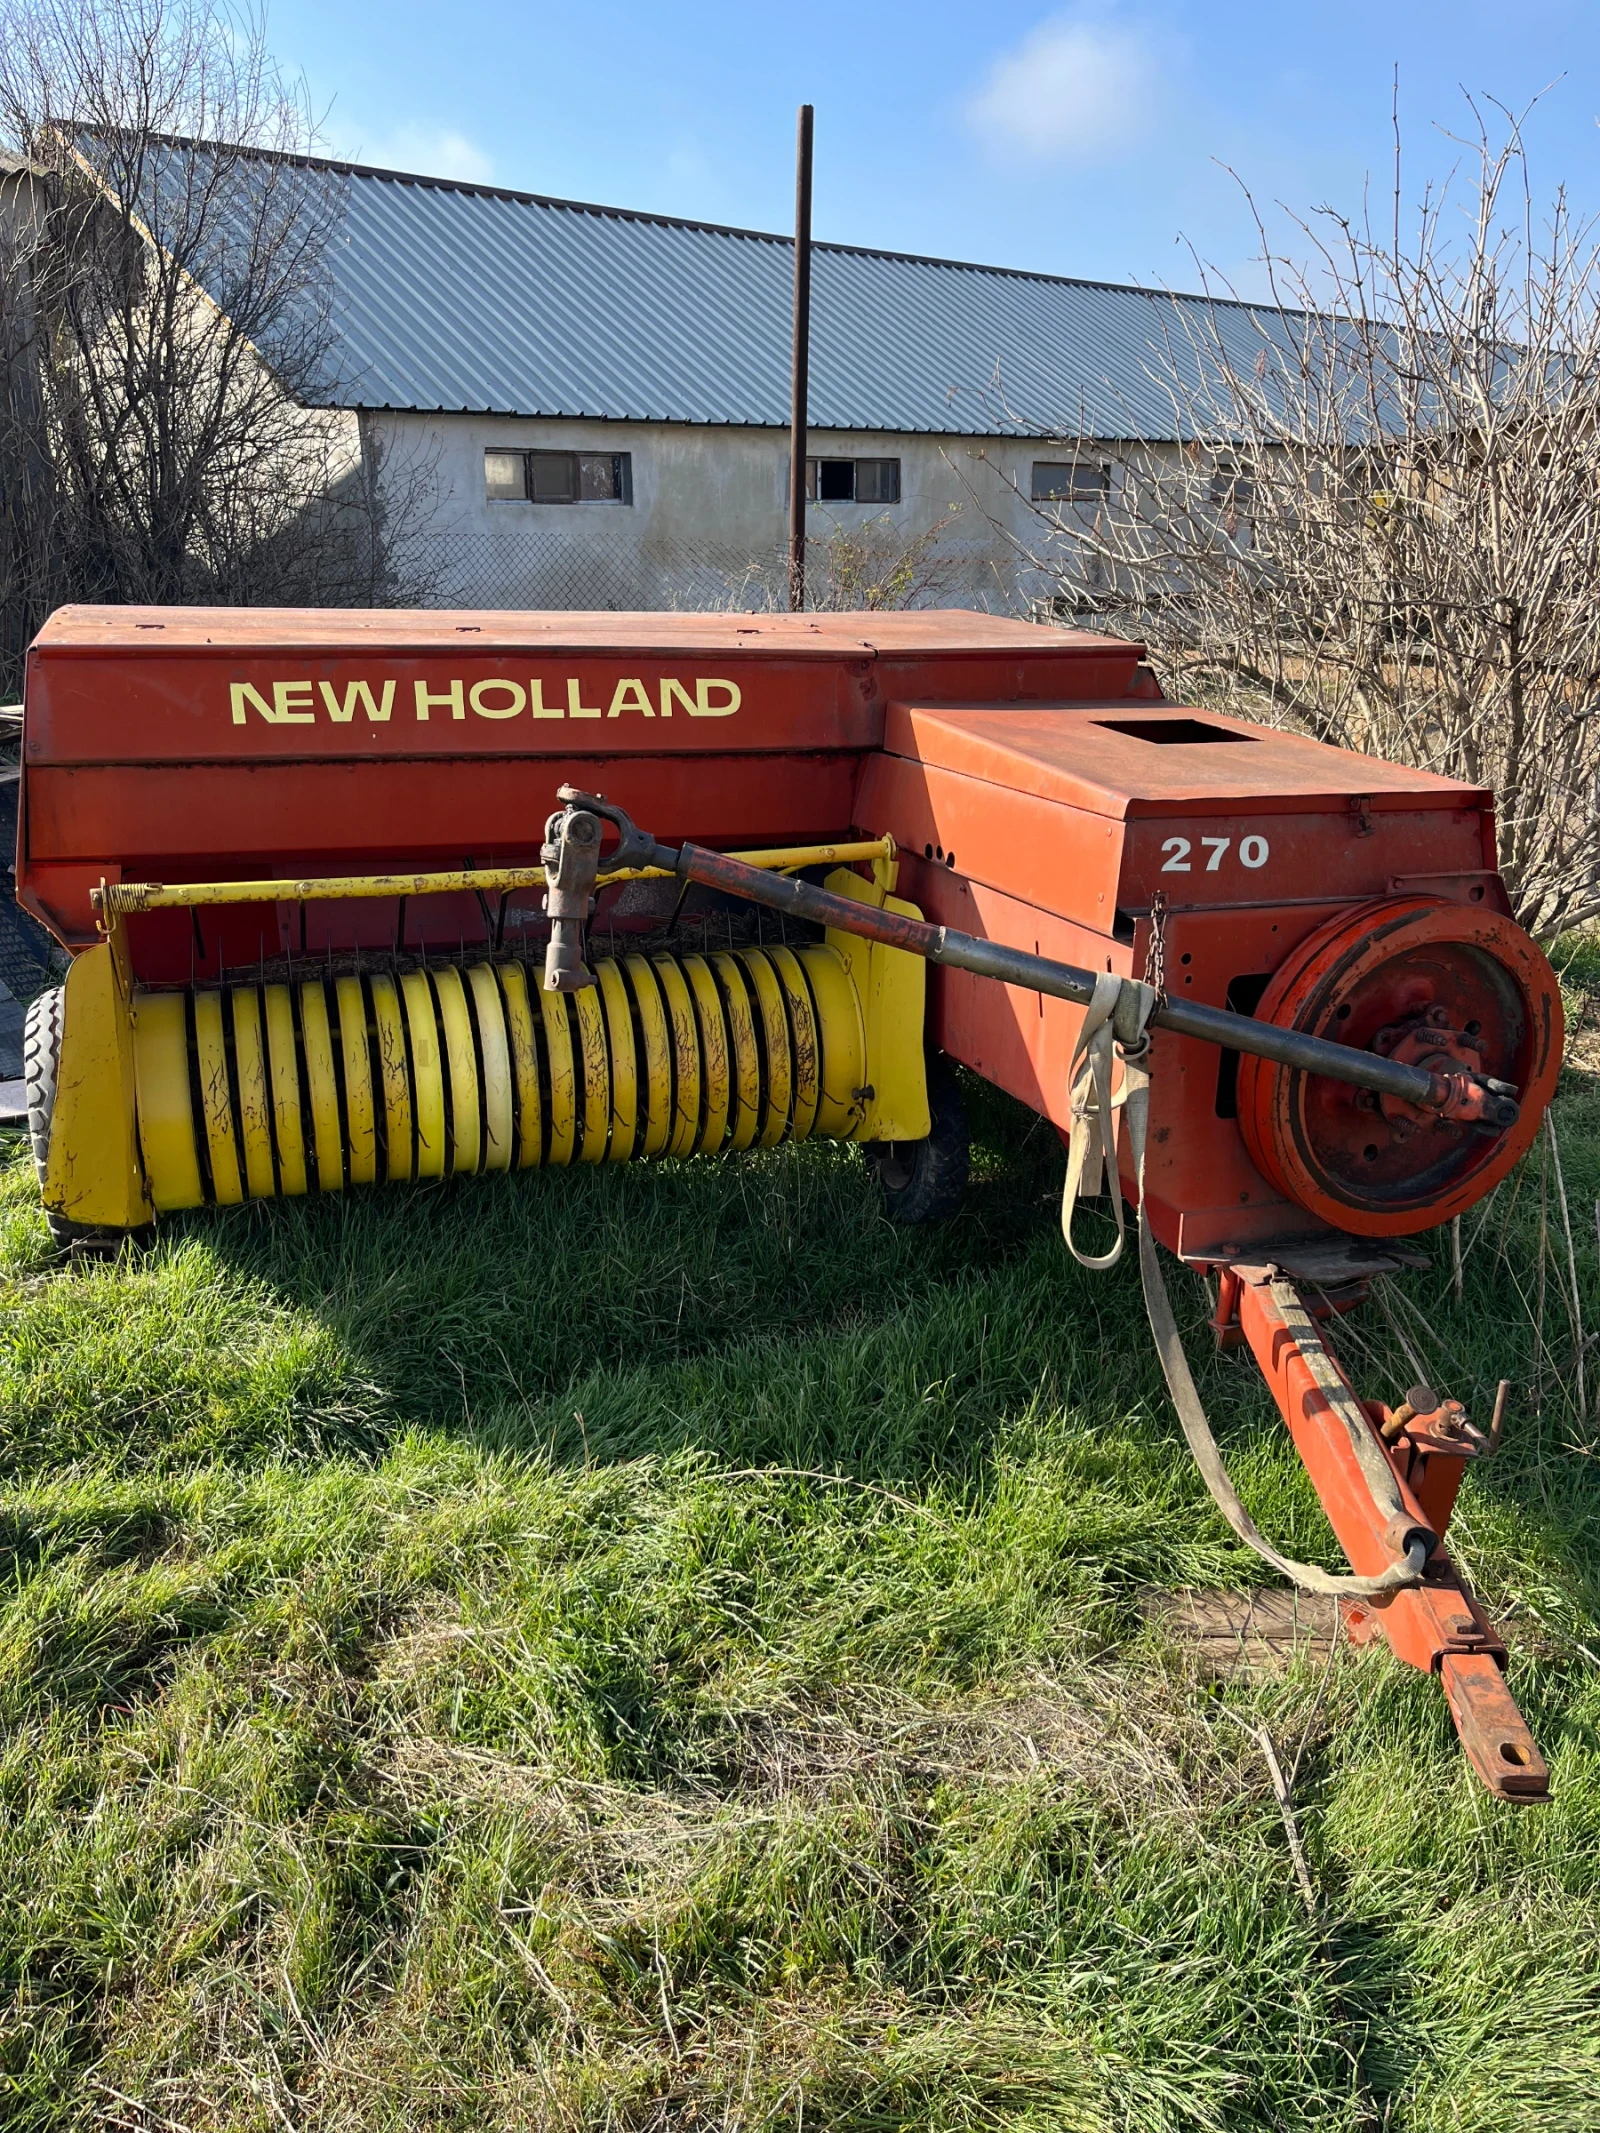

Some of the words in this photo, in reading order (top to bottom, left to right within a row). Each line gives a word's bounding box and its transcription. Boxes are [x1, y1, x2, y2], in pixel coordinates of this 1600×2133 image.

[230, 680, 396, 724] NEW
[414, 678, 742, 720] HOLLAND
[1161, 835, 1269, 872] 270
